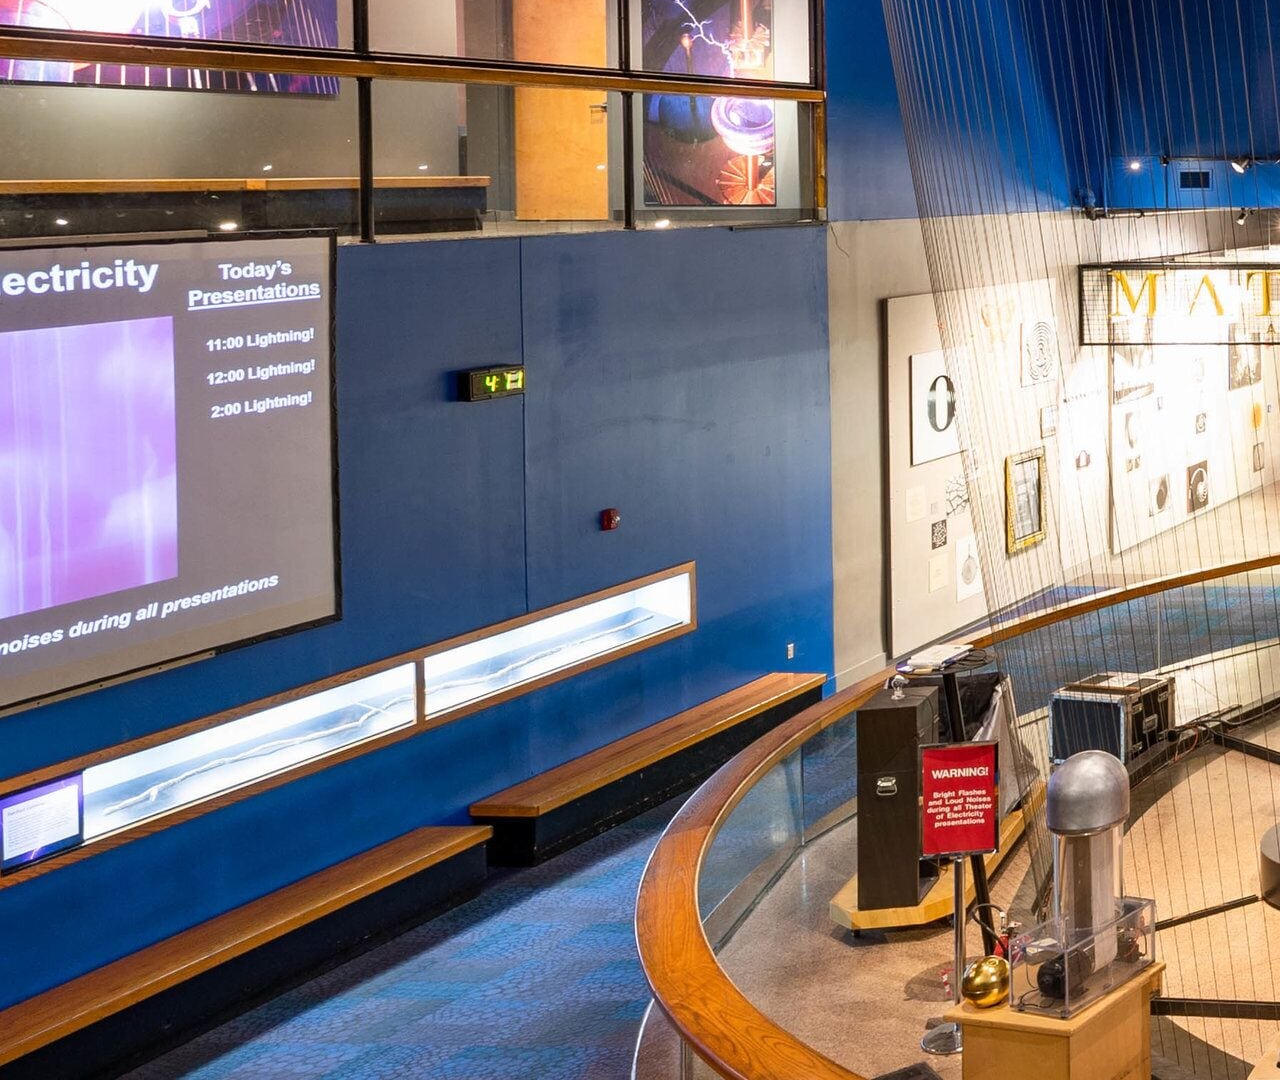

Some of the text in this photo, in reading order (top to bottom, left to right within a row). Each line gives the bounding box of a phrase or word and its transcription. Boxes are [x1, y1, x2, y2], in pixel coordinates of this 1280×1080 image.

[188, 282, 320, 307] Presentations
[1266, 323, 1276, 334] A
[206, 327, 315, 352] 11:00 Lightning!
[206, 359, 316, 385] 12:00 Lightning!
[211, 391, 312, 418] 2:00 Lightning!
[0, 575, 279, 655] noises during all presentations
[931, 766, 989, 779] WARNING!
[933, 789, 986, 799] Bright Flashes
[928, 796, 991, 806] and Loud Noises
[927, 806, 951, 814] during
[947, 810, 984, 819] Electricity
[934, 817, 985, 828] presentations
